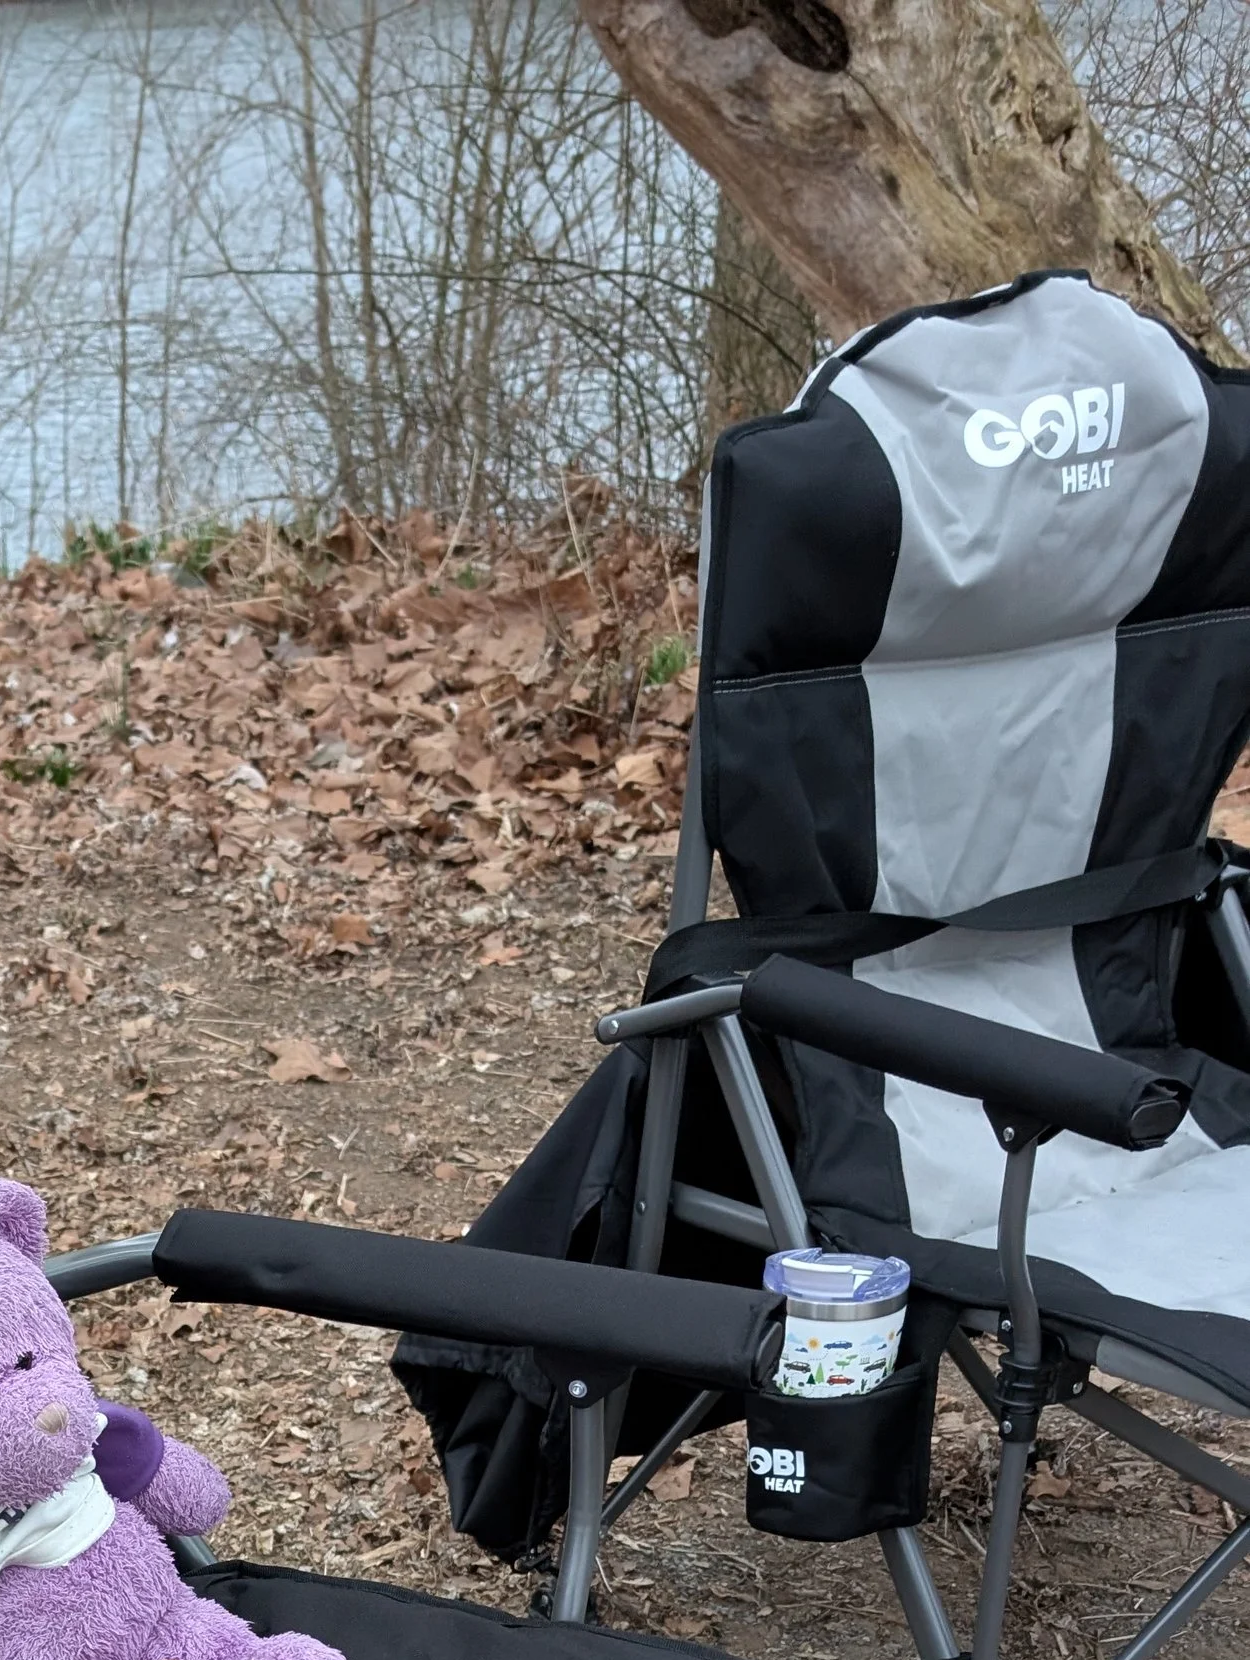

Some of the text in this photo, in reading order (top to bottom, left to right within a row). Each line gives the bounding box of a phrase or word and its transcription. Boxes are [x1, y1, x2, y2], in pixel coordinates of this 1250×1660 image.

[963, 382, 1125, 468] GOBI
[1061, 459, 1114, 495] HEAT
[746, 1438, 805, 1478] OBI
[764, 1476, 805, 1493] HEAT
